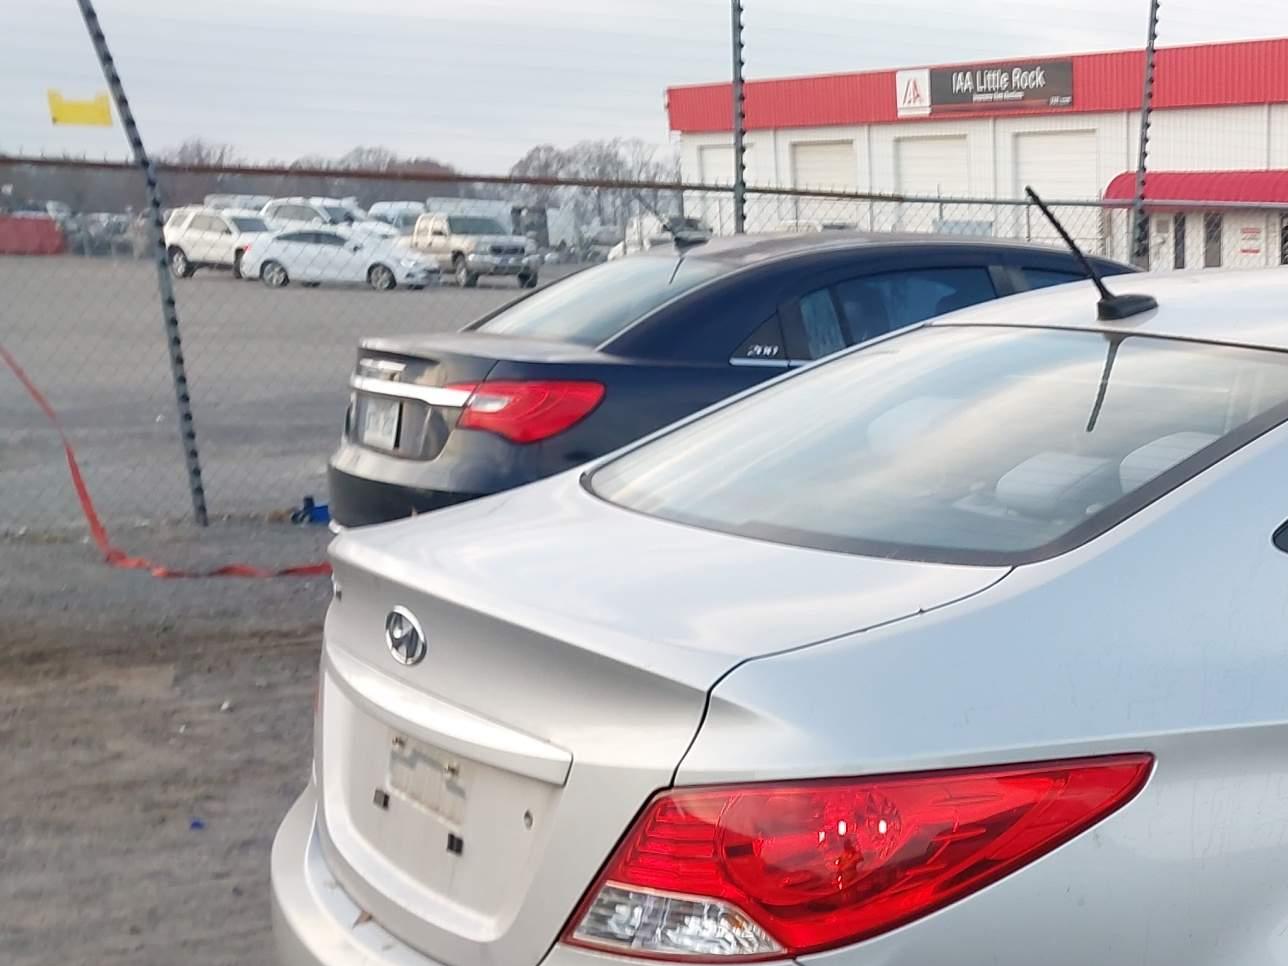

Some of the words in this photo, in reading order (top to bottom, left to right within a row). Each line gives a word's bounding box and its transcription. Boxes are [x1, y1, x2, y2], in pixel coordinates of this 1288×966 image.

[952, 71, 974, 94] IAA
[976, 69, 1010, 92] Little
[1012, 66, 1046, 90] Rock
